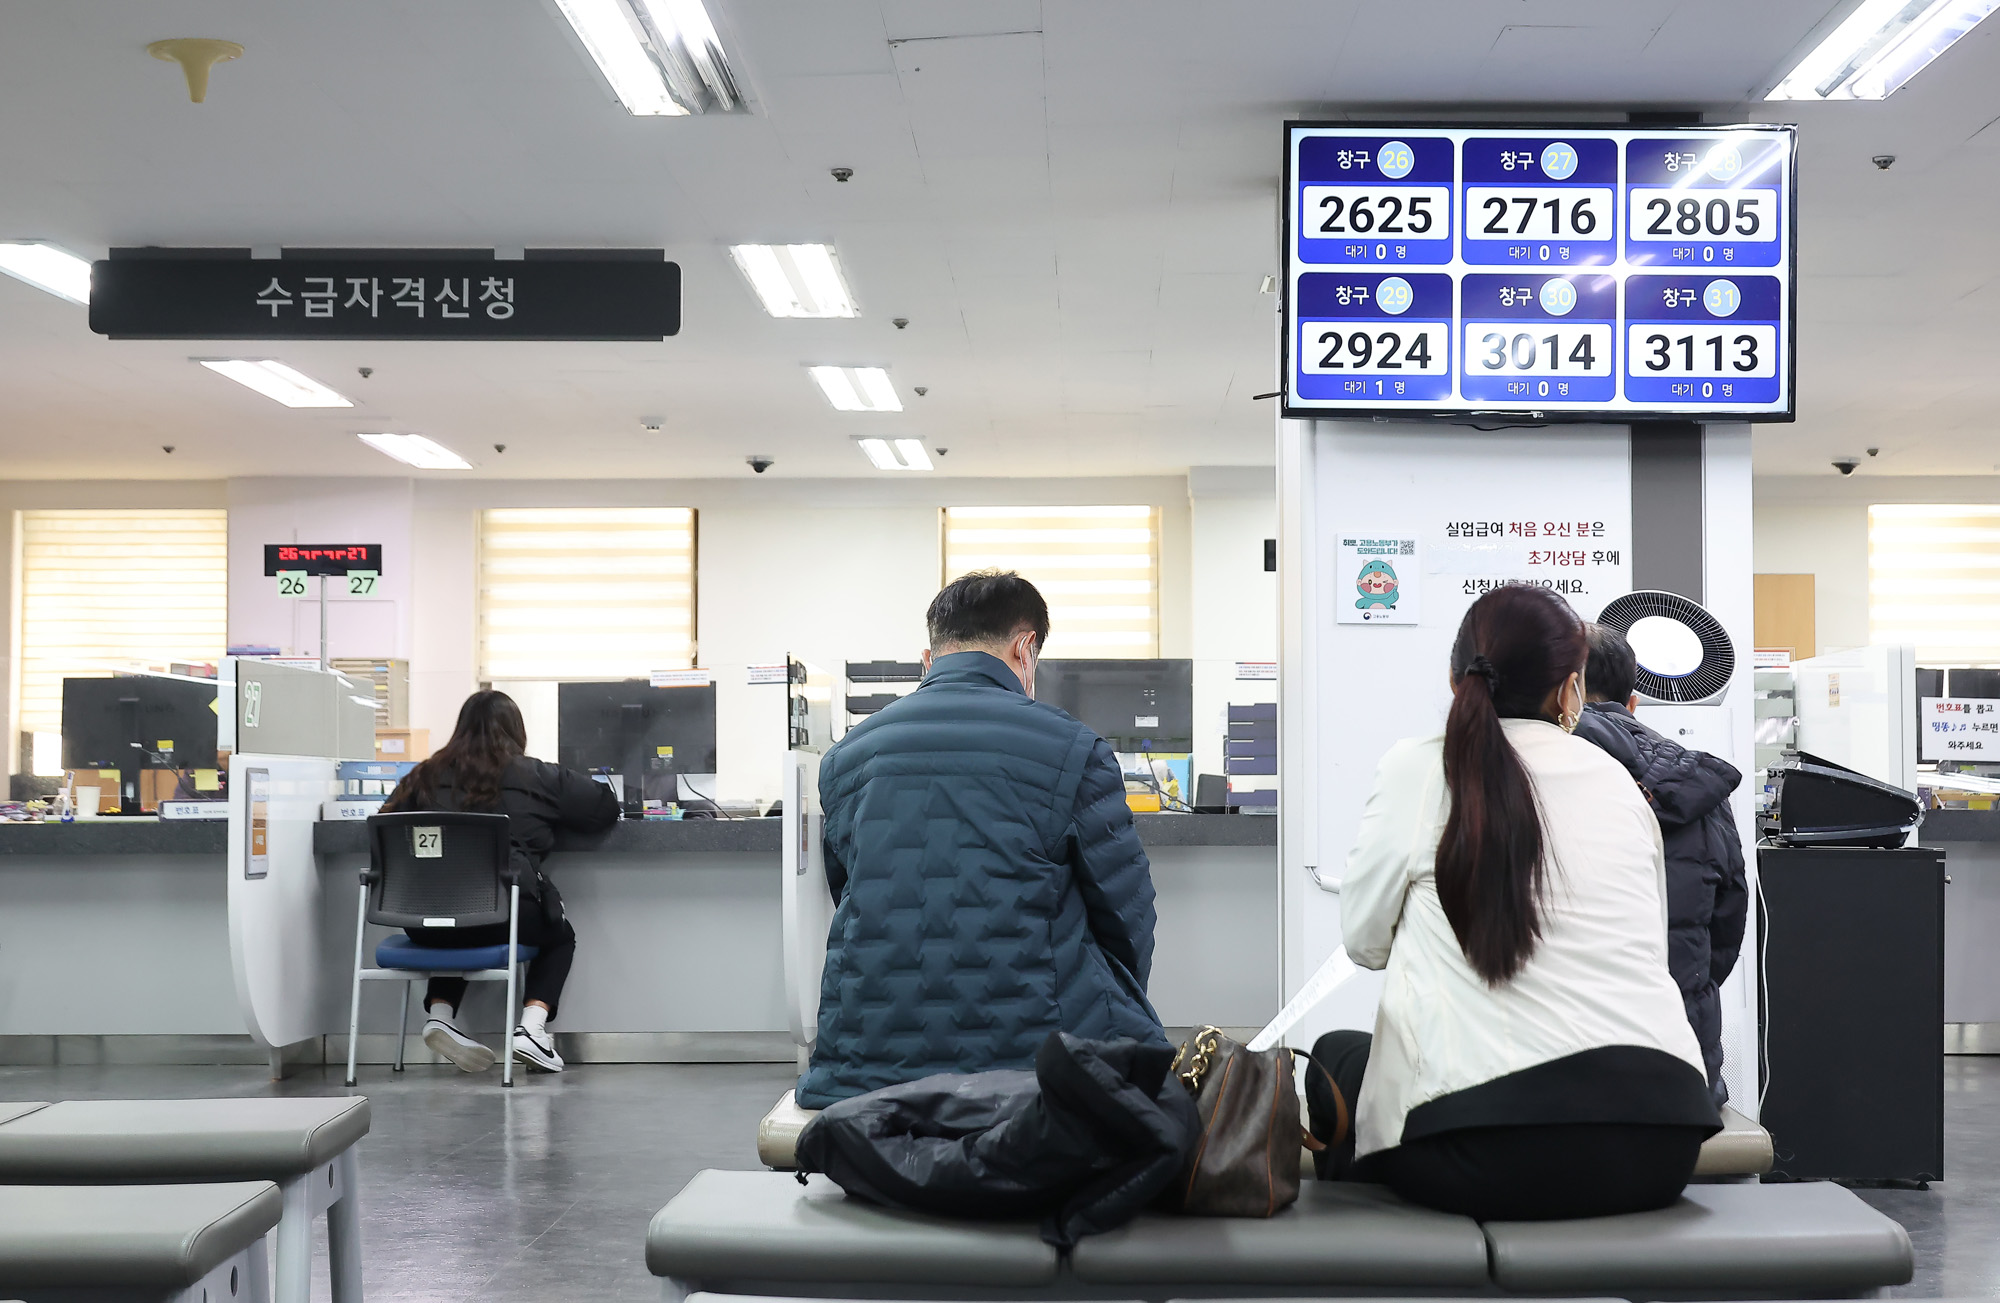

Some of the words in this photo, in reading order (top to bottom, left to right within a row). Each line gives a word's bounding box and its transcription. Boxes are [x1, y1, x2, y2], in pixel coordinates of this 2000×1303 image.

[1337, 149, 1370, 170] 창구
[1384, 151, 1409, 169] 26
[1500, 150, 1534, 171] 창구
[1547, 152, 1572, 171] 27
[1664, 151, 1698, 172] 창구
[1319, 196, 1432, 234] 2625
[1483, 197, 1596, 235] 2716
[1647, 198, 1759, 236] 2805
[1345, 245, 1367, 259] 대기
[1375, 244, 1387, 260] 0
[1395, 245, 1407, 259] 명
[1509, 246, 1531, 260] 대기
[1539, 245, 1550, 261] 0
[1559, 246, 1570, 260] 명
[1672, 247, 1695, 261] 대기
[1702, 246, 1714, 262] 0
[1723, 247, 1734, 261] 명
[256, 276, 515, 320] 수급자격신청
[1336, 285, 1369, 306] 창구
[1383, 287, 1408, 305] 29
[1499, 286, 1533, 307] 창구
[1546, 288, 1571, 306] 30
[1663, 287, 1696, 308] 창구
[1710, 289, 1735, 307] 31
[1318, 331, 1431, 369] 2924
[1482, 333, 1595, 370] 3014
[1646, 334, 1759, 371] 3113
[1344, 380, 1366, 394] 대기
[1375, 379, 1384, 395] 1
[1394, 380, 1405, 395] 명
[1508, 382, 1530, 396] 대기
[1538, 380, 1549, 397] 0
[1558, 382, 1569, 396] 명
[1671, 383, 1694, 397] 대기
[1702, 382, 1713, 398] 0
[1721, 383, 1733, 397] 명
[1446, 522, 1504, 537] 실업급여
[1509, 521, 1537, 537] 처음
[1543, 521, 1571, 537] 오신
[1576, 521, 1605, 537] 분은
[1528, 550, 1586, 566] 초기상담
[1591, 550, 1620, 566] 후에
[280, 577, 305, 594] 26
[350, 576, 375, 594] 27
[245, 681, 261, 728] 27
[1936, 703, 1971, 714] 번호표를
[1972, 723, 1999, 733] 누르면
[1948, 740, 1983, 750] 와주세요
[419, 834, 438, 847] 27
